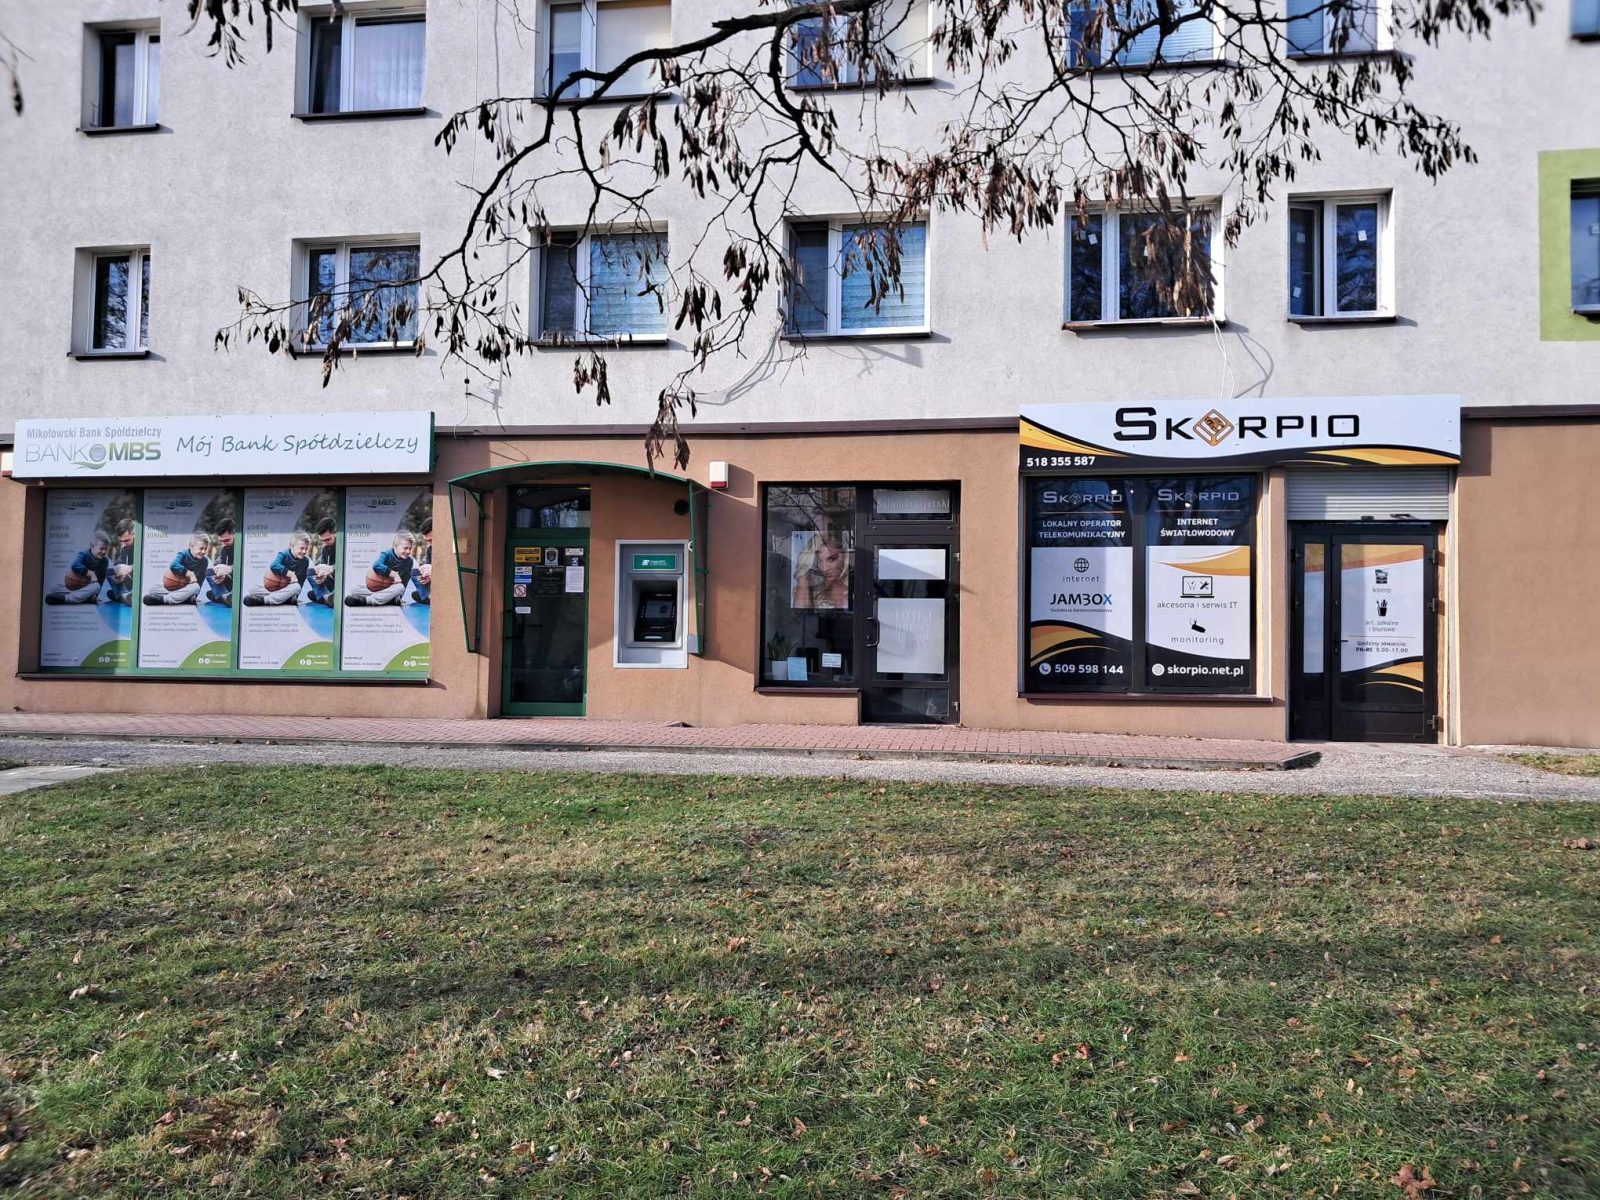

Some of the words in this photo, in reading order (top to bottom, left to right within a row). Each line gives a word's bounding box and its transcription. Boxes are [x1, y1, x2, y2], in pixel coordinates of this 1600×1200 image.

[26, 427, 77, 439] Mikołowski
[79, 426, 102, 438] Bank
[104, 426, 162, 439] Spółdzielczy
[176, 435, 214, 457] Mój
[221, 434, 279, 453] Bank
[282, 432, 419, 455] Spółdzielczy
[1026, 457, 1049, 468] 518
[1050, 456, 1072, 467] 355
[1073, 456, 1096, 467] 587
[1042, 520, 1079, 528] LOKALNY
[1079, 519, 1122, 528] OPERATOR
[1176, 518, 1219, 526] INTERNET
[1039, 531, 1126, 539] TELEKOMUNIKACYJNY
[1160, 527, 1236, 537] ŚWIATŁOWODOWY
[1062, 575, 1101, 583] internet
[1156, 601, 1195, 609] akcesoria
[1202, 601, 1227, 609] serwis
[1229, 601, 1238, 609] IT
[1171, 636, 1224, 645] monitoring
[1054, 664, 1076, 673] 509
[1078, 664, 1099, 674] 598
[1103, 665, 1124, 674] 144
[1167, 664, 1244, 677] skorpio.net.pl
